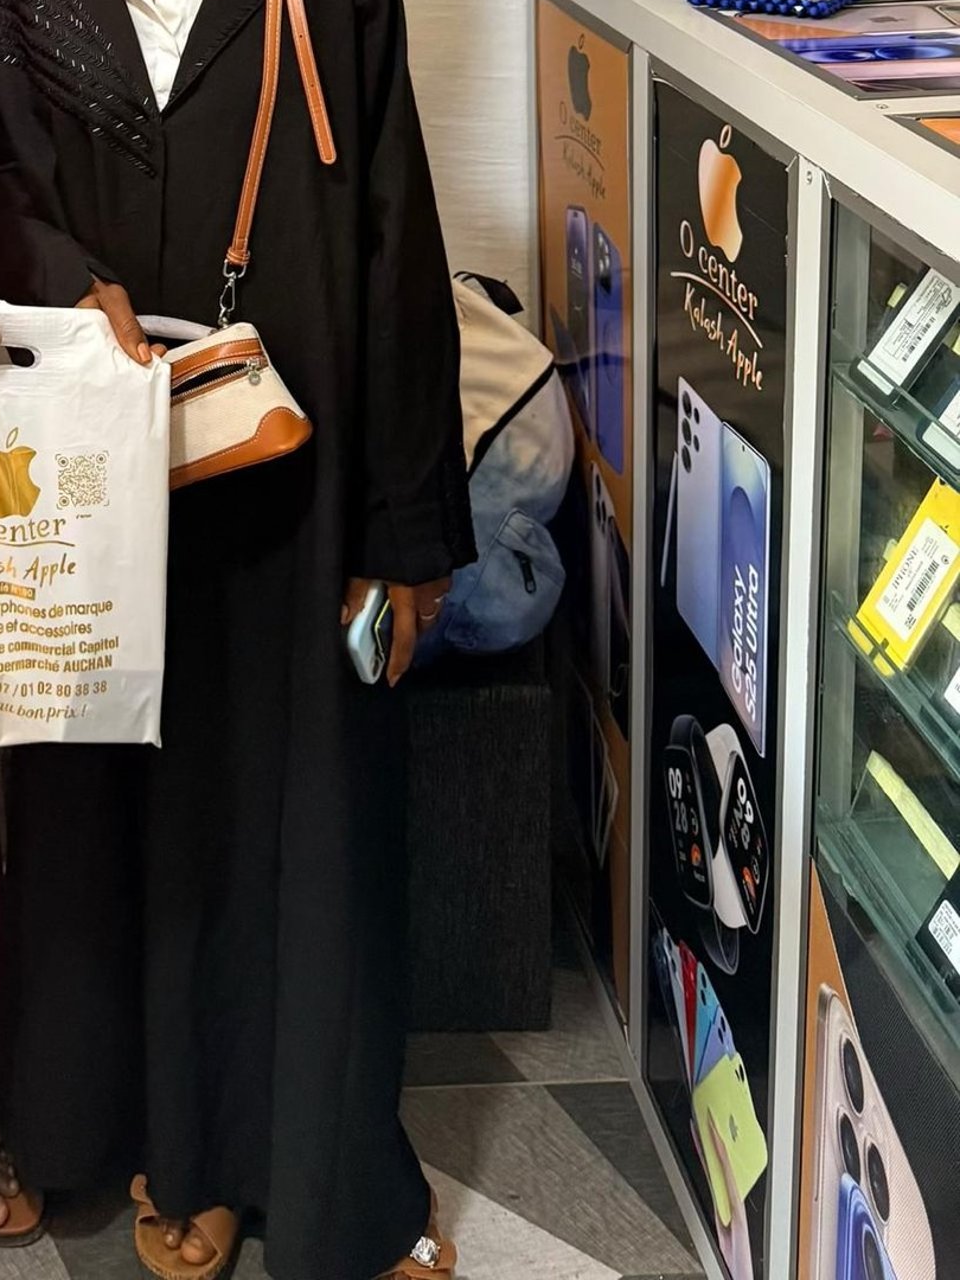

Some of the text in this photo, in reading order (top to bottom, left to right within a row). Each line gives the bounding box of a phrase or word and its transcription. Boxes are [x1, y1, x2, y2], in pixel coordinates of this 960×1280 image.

[680, 219, 759, 321] O center
[684, 281, 763, 391] Kalash Apple
[22, 552, 77, 588] Apple
[48, 605, 64, 619] de
[65, 599, 113, 618] marque
[5, 619, 18, 633] et
[19, 621, 93, 638] accessoires
[731, 564, 747, 694] Galaxy
[744, 563, 759, 723] S25 Ultra
[7, 639, 76, 656] commercial
[78, 636, 120, 656] Capitol
[62, 654, 113, 673] AUCHAN
[20, 683, 34, 697] 01
[37, 681, 52, 695] 02
[56, 683, 72, 697] 80
[75, 682, 90, 696] 38
[93, 680, 108, 694] 38
[17, 703, 46, 719] bon
[46, 704, 77, 722] prix
[668, 767, 755, 824] 09 09
[673, 800, 688, 834] 28
